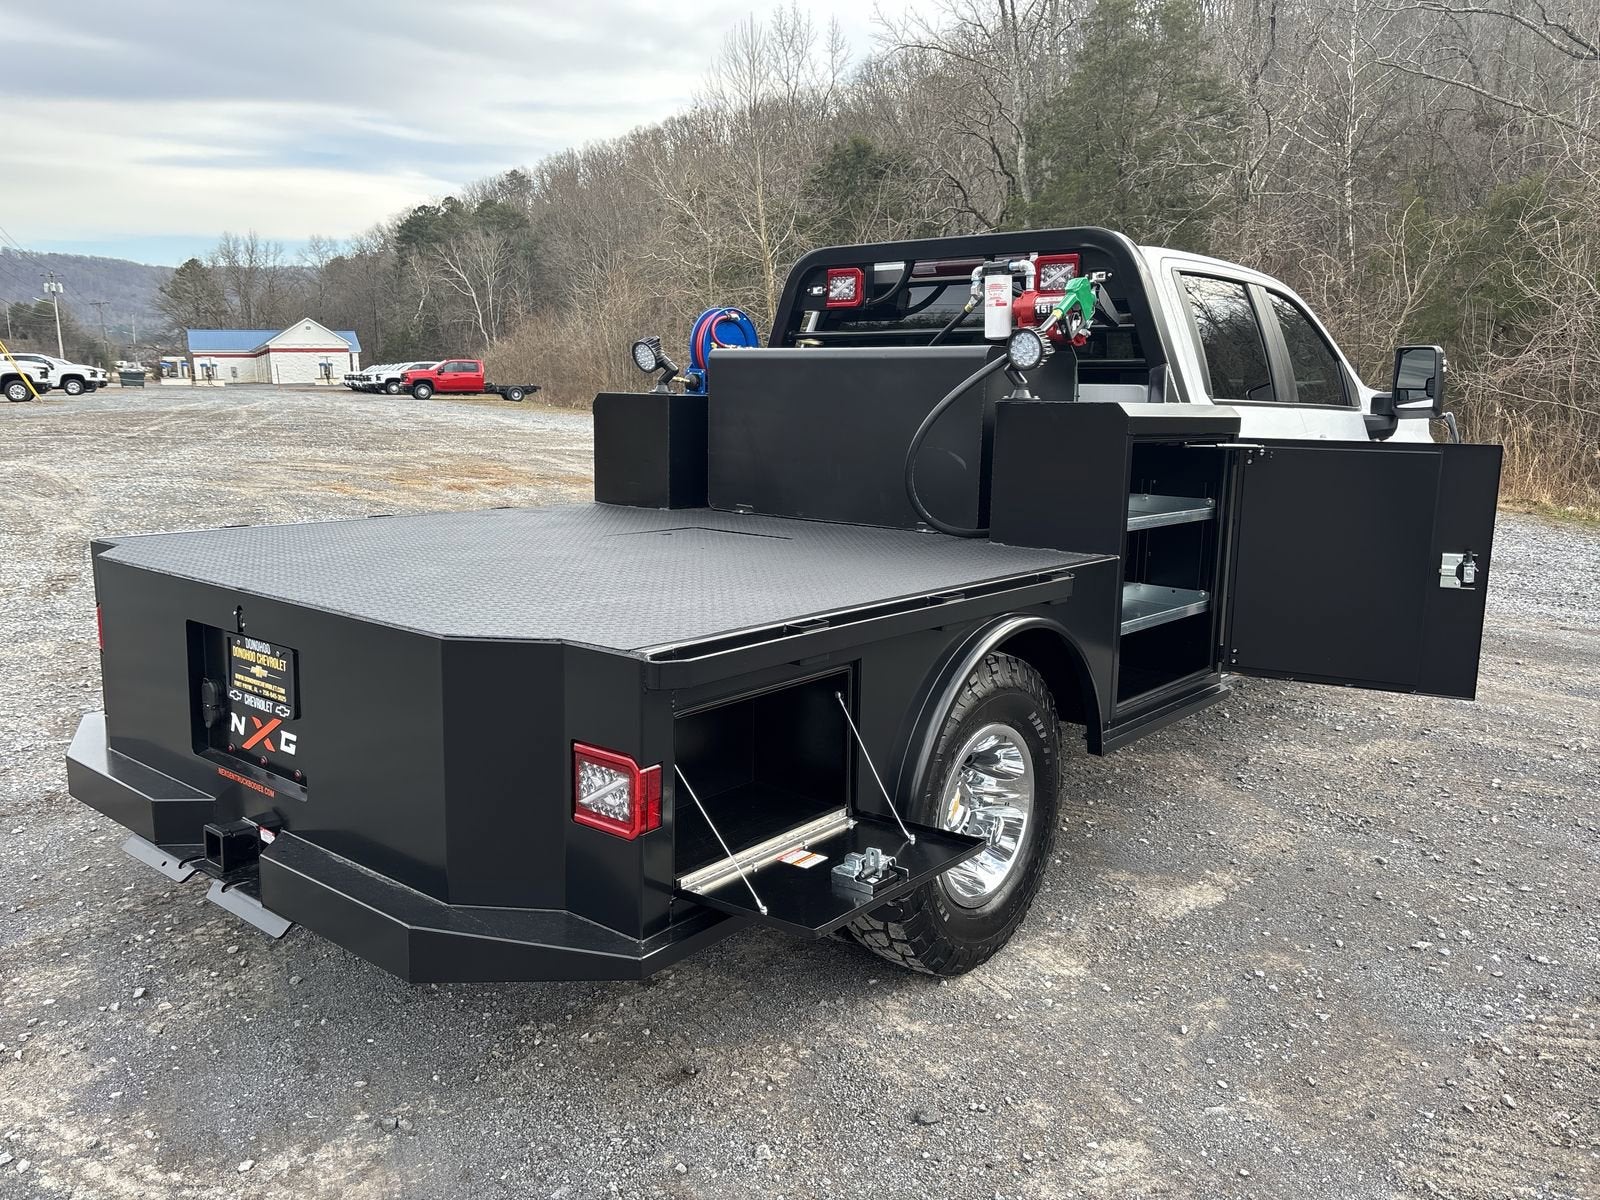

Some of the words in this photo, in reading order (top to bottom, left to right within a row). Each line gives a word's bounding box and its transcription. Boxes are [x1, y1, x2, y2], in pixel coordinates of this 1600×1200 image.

[245, 637, 271, 655] DONOHOO
[232, 645, 256, 663] DONOHOO
[256, 652, 287, 672] CHEVROLET
[244, 694, 273, 714] CHEVROLET
[230, 711, 297, 756] NXG
